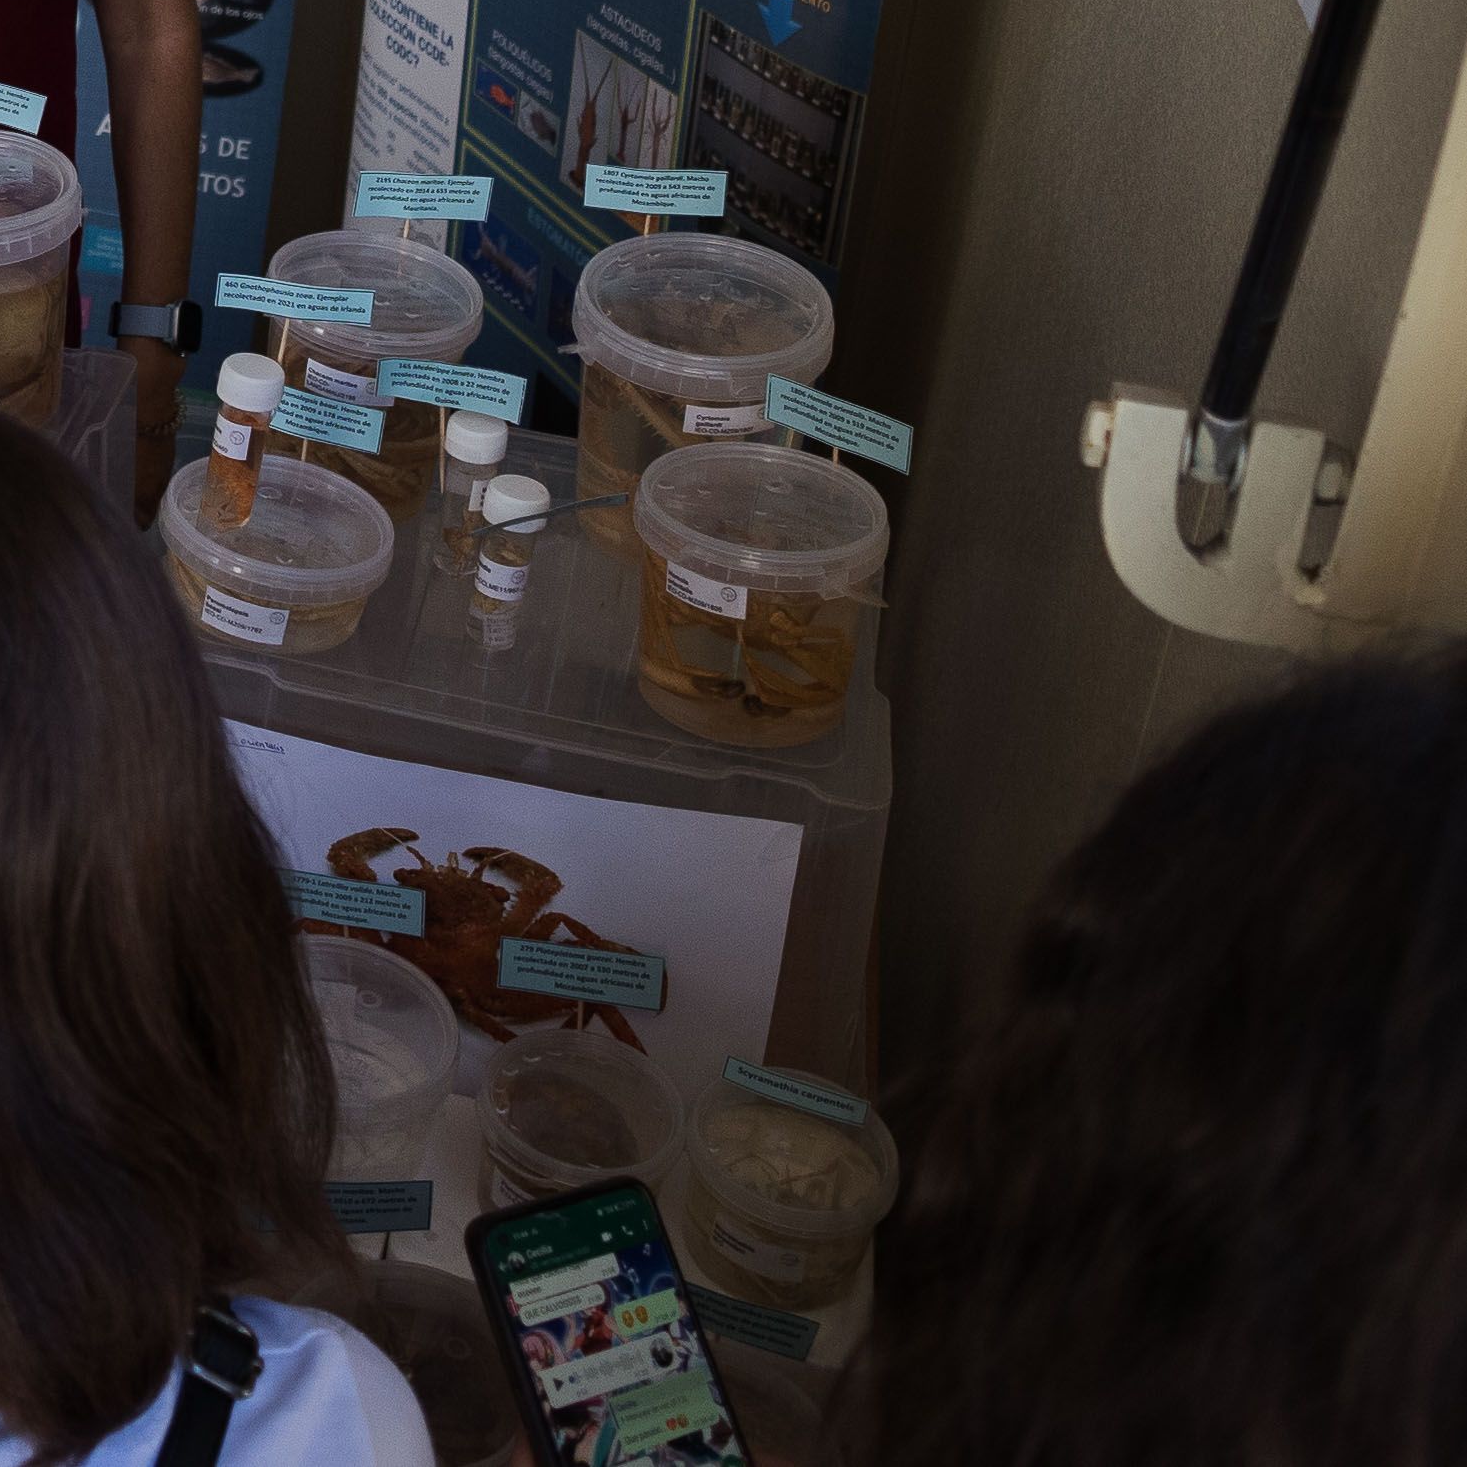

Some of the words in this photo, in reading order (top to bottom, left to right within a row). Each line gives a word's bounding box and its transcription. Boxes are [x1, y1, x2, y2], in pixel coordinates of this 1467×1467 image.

[219, 138, 252, 161] DE
[317, 292, 349, 302] Ejemplar
[308, 304, 328, 312] aguas
[330, 304, 339, 312] de
